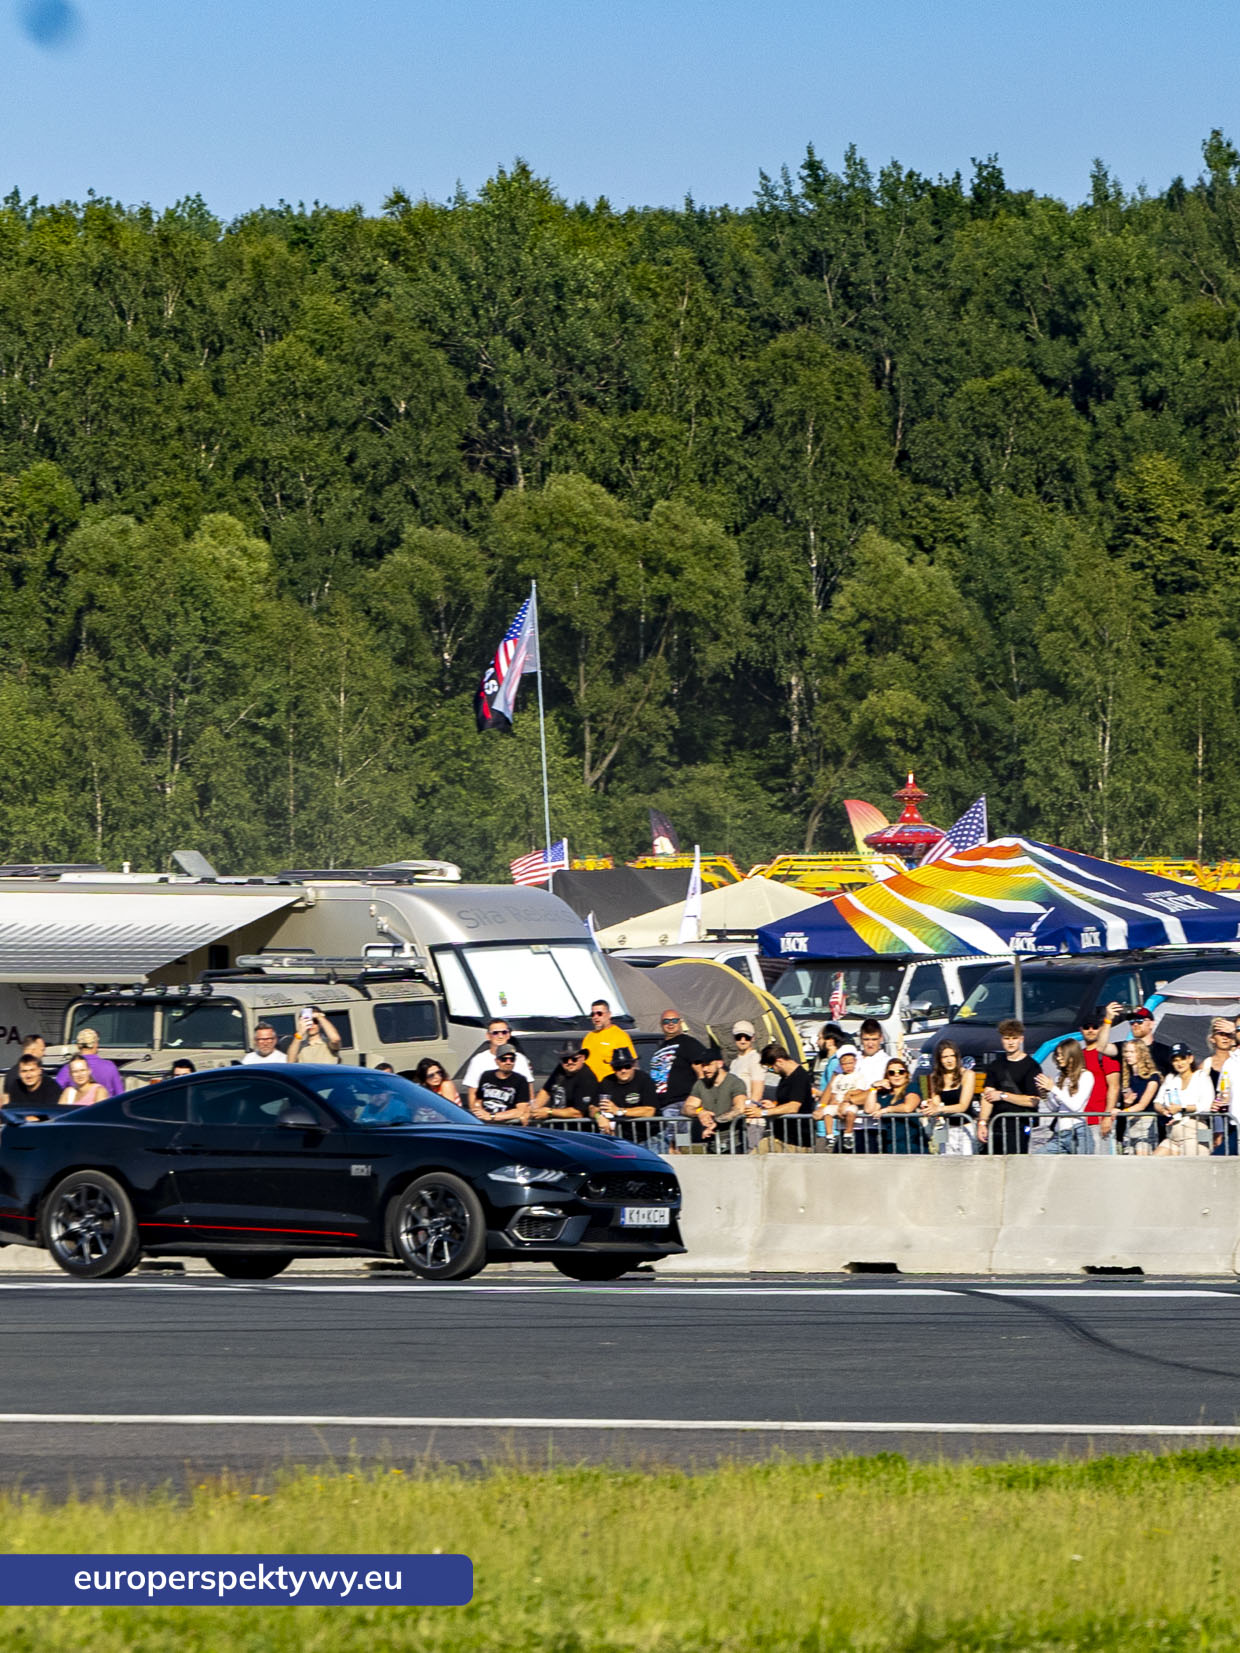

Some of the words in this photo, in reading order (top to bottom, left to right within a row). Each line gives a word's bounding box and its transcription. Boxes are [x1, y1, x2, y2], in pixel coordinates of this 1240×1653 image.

[1144, 894, 1219, 913] JACK
[780, 937, 809, 953] JACK
[1009, 936, 1038, 952] JACK
